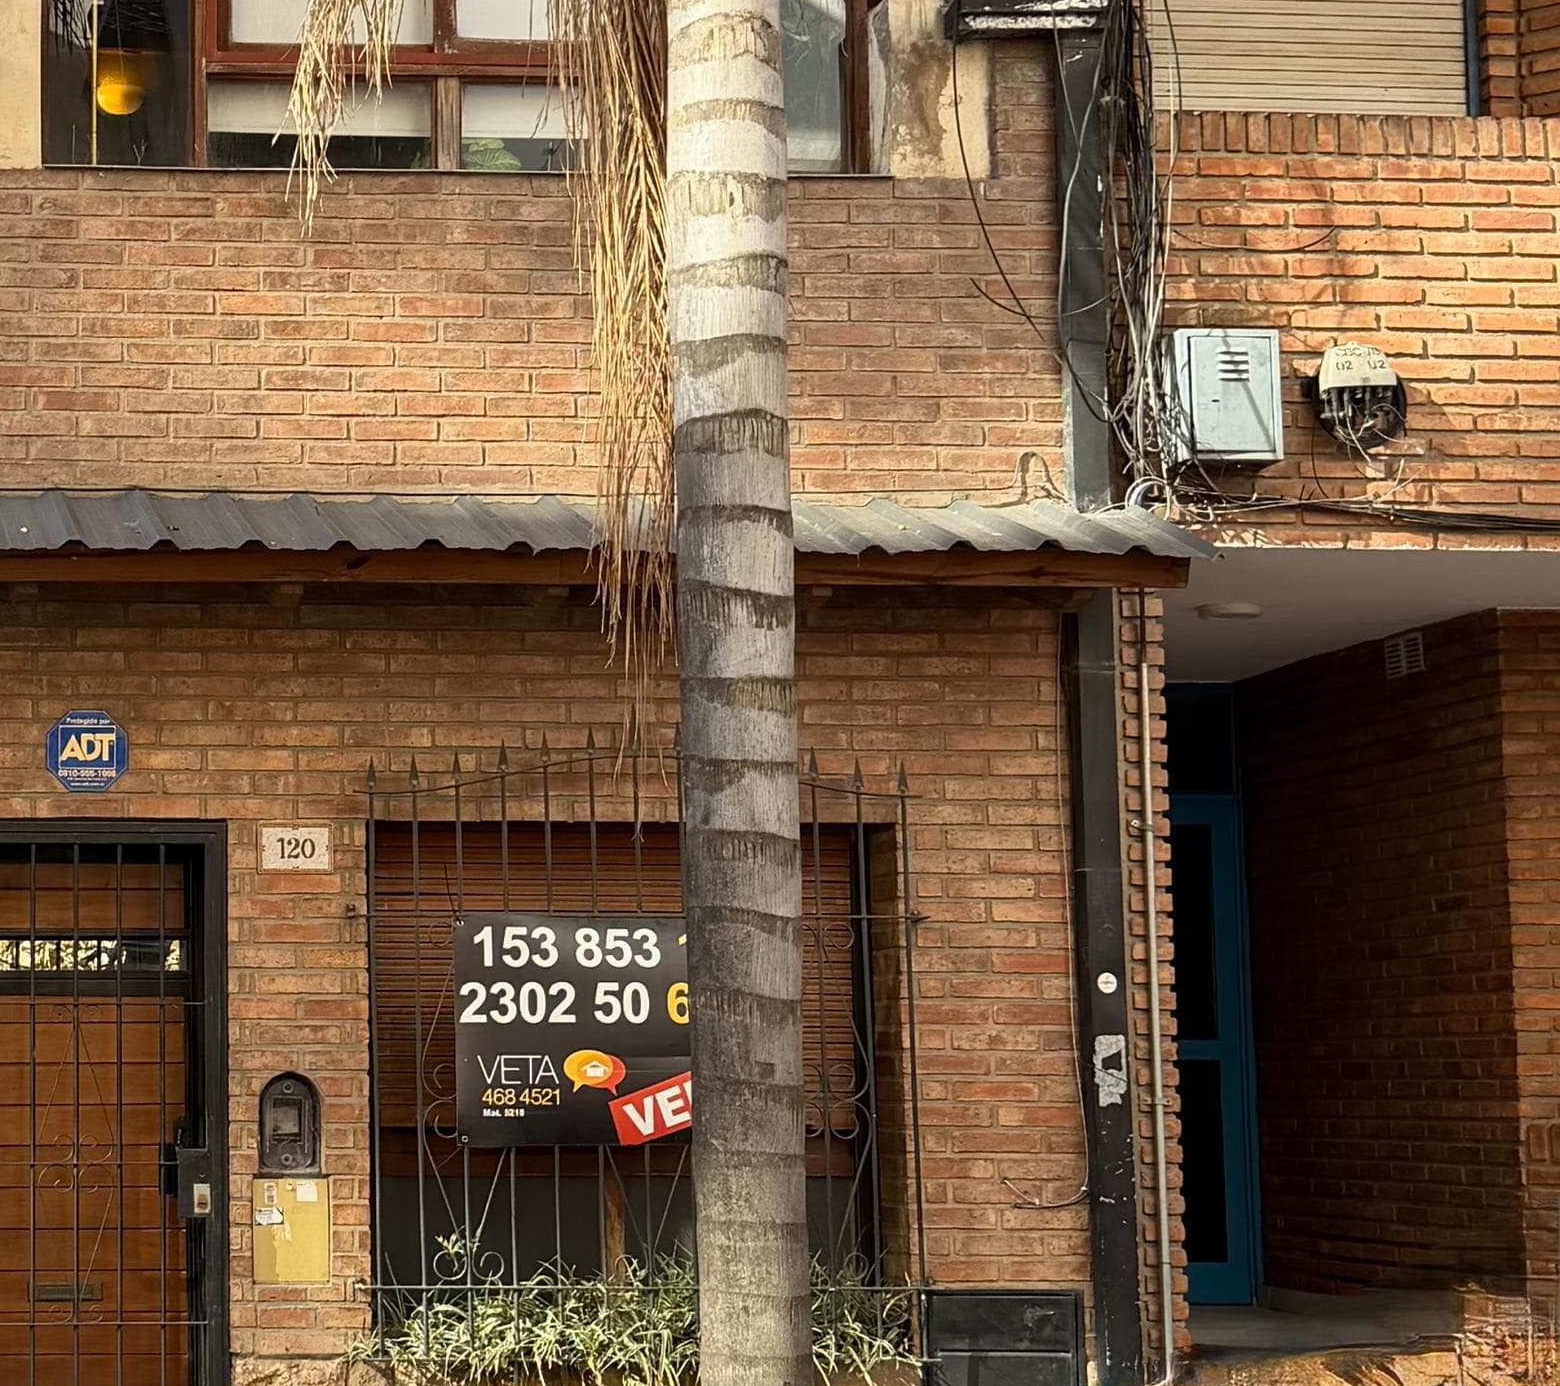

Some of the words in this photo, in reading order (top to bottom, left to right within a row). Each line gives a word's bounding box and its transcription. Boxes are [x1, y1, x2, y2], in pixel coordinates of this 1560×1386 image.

[60, 733, 115, 761] ADT
[276, 837, 316, 859] 120
[473, 926, 559, 968] 153
[574, 928, 661, 968] 853
[459, 981, 576, 1024] 2302
[593, 982, 650, 1024] 50
[477, 1054, 560, 1085] VETA
[482, 1088, 516, 1105] 468
[519, 1088, 561, 1105] 4521
[622, 1080, 692, 1136] VE
